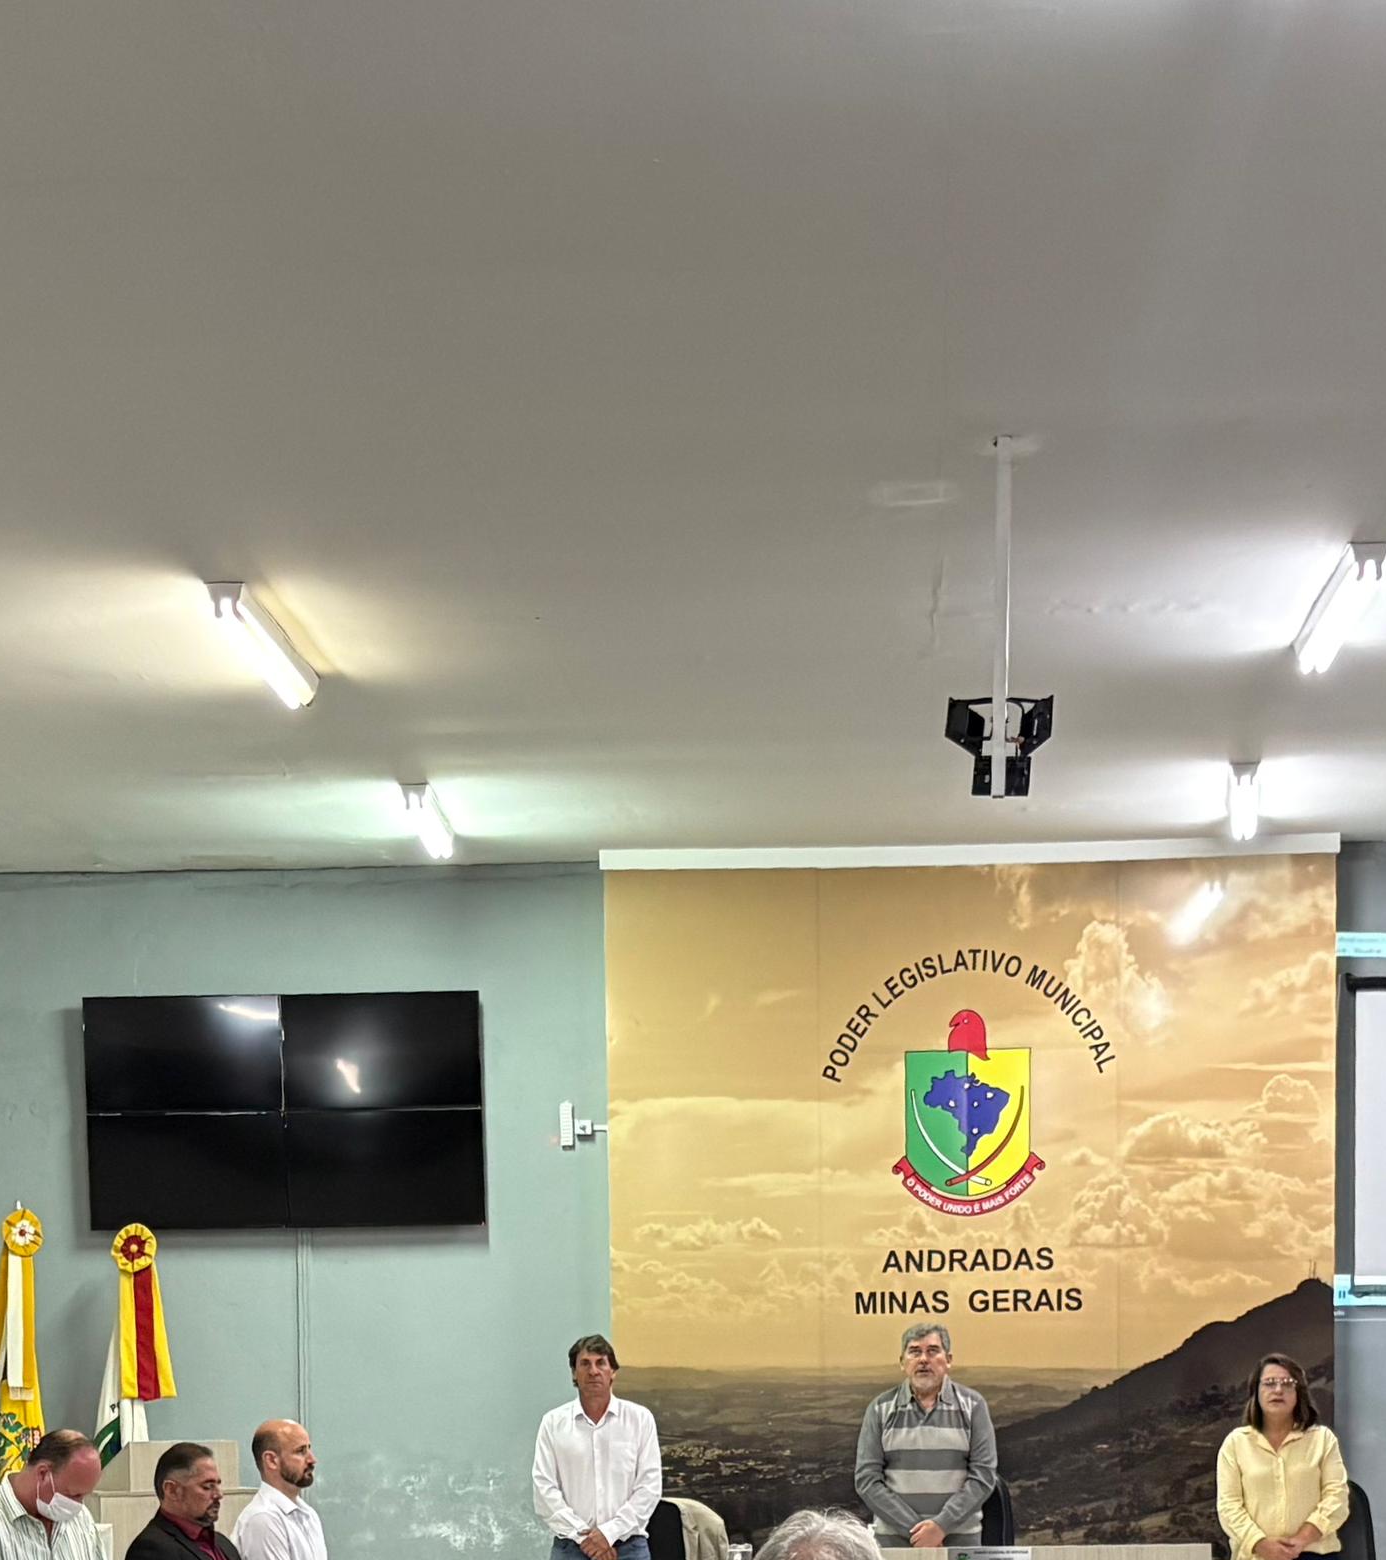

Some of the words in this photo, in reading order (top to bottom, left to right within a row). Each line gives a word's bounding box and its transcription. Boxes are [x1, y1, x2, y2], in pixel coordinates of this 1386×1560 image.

[822, 1004, 879, 1083] PODER
[873, 949, 1022, 1009] LEGISLATIVO
[1025, 964, 1116, 1073] MUNICIPAL
[907, 1178, 914, 1186] O
[913, 1184, 942, 1209] PODER
[943, 1203, 972, 1214] UNIDO
[974, 1201, 981, 1212] É
[982, 1196, 1005, 1210] MAIS
[1004, 1174, 1033, 1199] FORTE
[882, 1247, 1055, 1273] ANDRADAS
[855, 1291, 950, 1315] MINAS
[968, 1288, 1083, 1313] GERAIS
